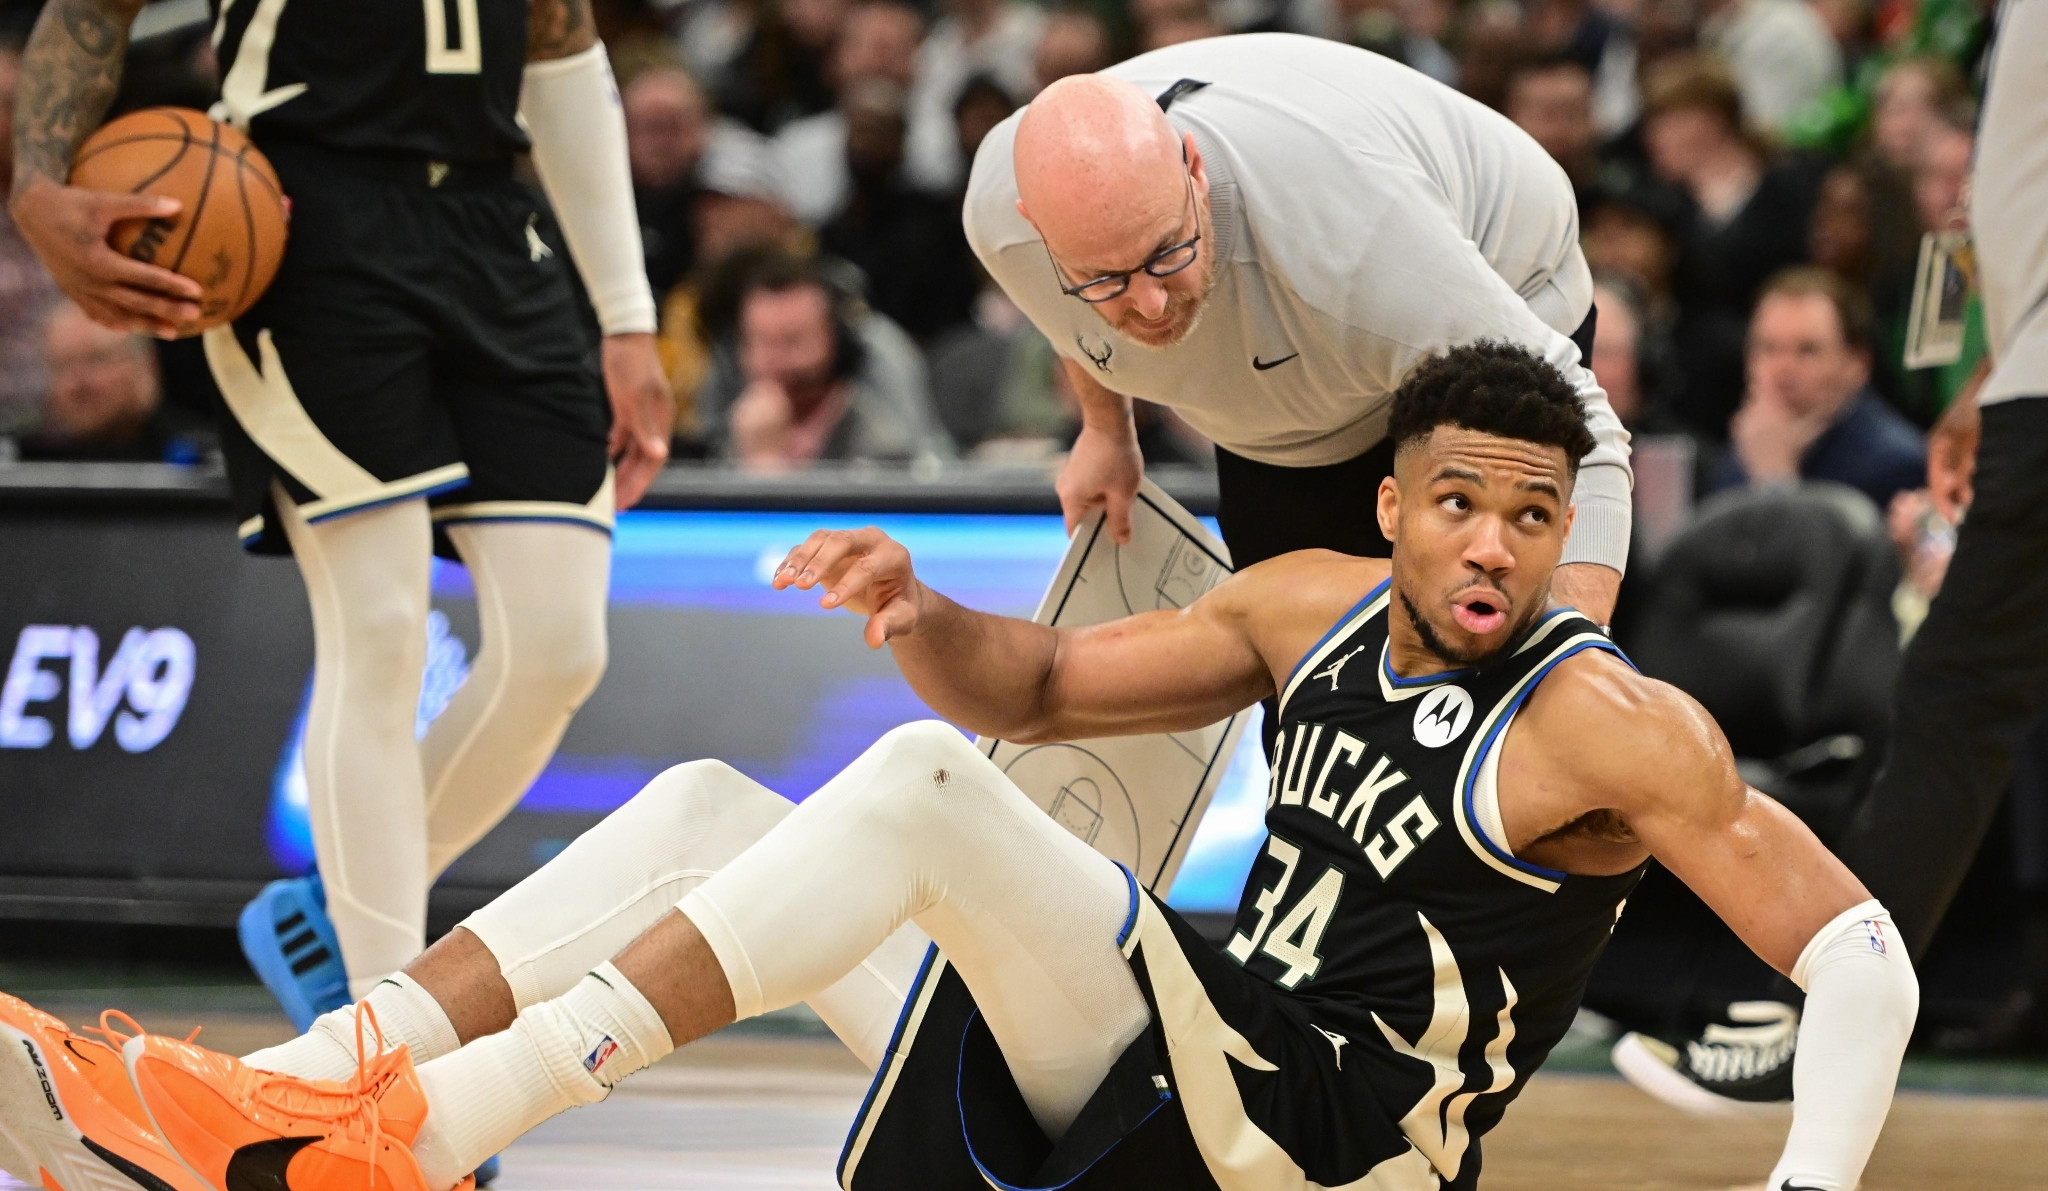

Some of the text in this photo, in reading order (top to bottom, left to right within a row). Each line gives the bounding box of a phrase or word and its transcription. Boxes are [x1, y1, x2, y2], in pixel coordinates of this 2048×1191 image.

[0, 624, 196, 753] EV9
[1266, 720, 1442, 883] BUCKS
[1225, 829, 1346, 991] 34
